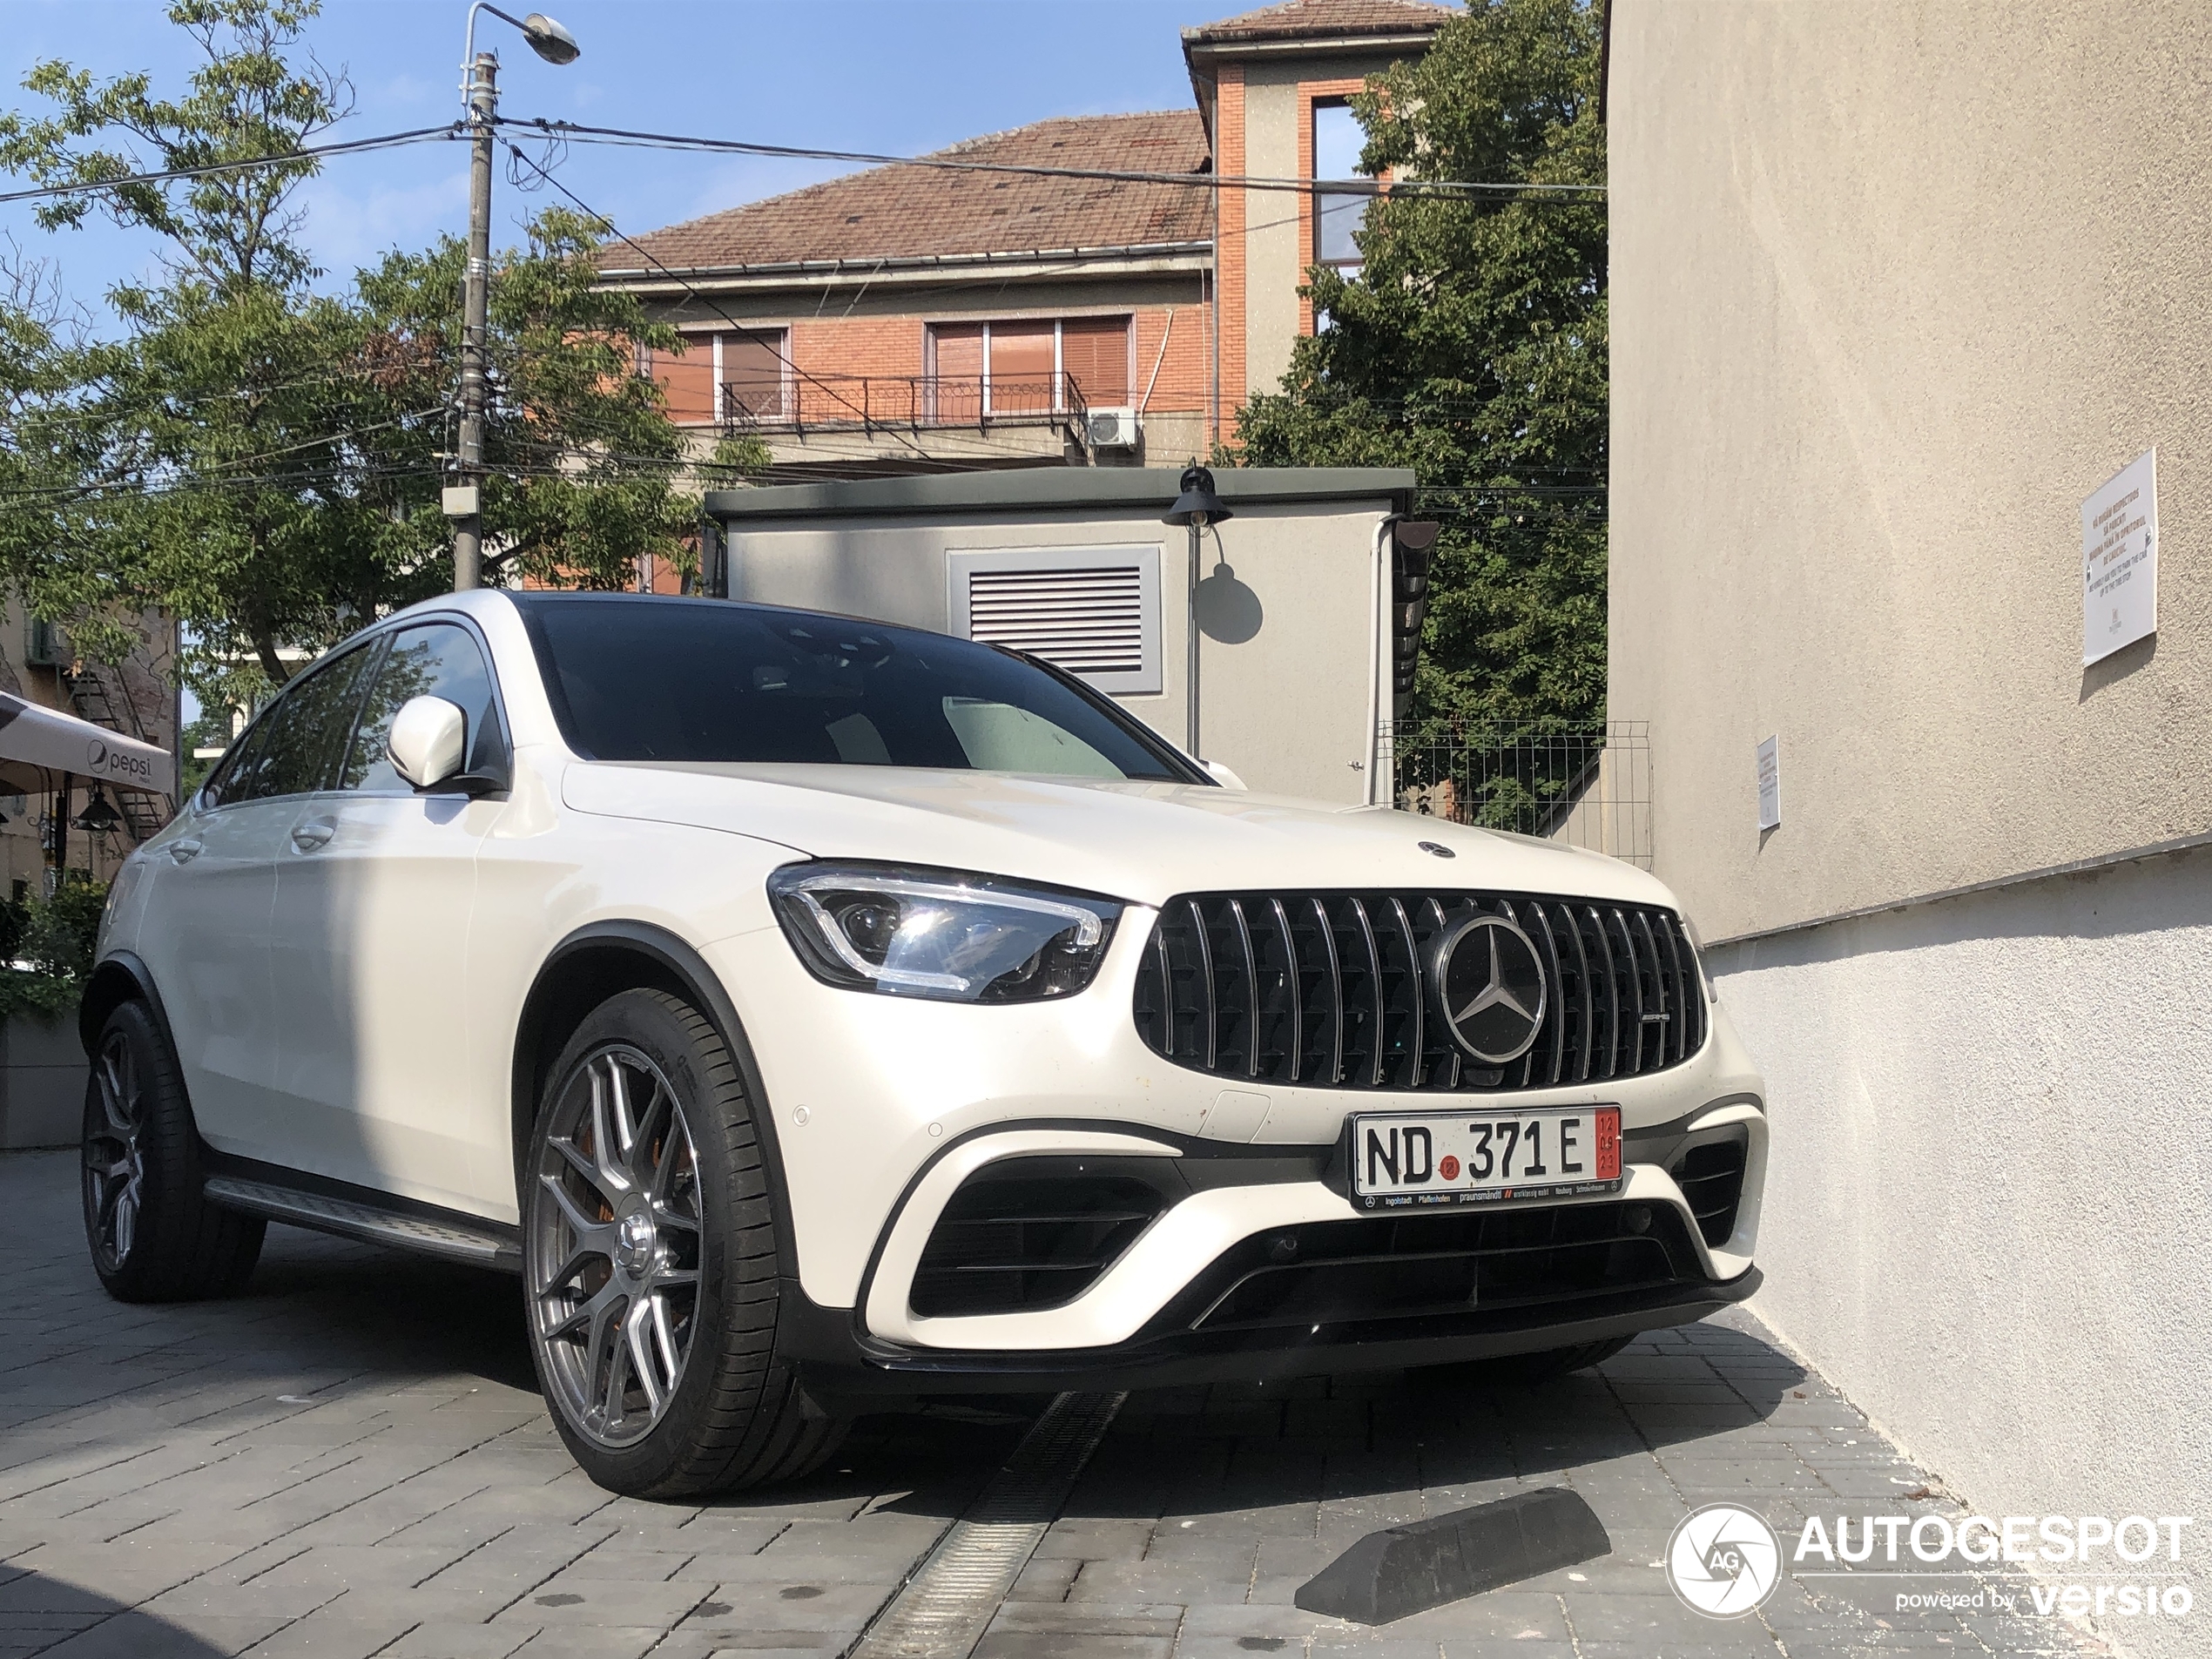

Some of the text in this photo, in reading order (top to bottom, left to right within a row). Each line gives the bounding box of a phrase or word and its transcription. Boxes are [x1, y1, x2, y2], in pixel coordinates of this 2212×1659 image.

[110, 753, 152, 777] pepsi
[1600, 1116, 1613, 1131] 12
[1367, 1118, 1582, 1185] ND 371 E
[1385, 1197, 1413, 1206] Ingolstadt
[1418, 1194, 1451, 1204] Pfaffenhofen
